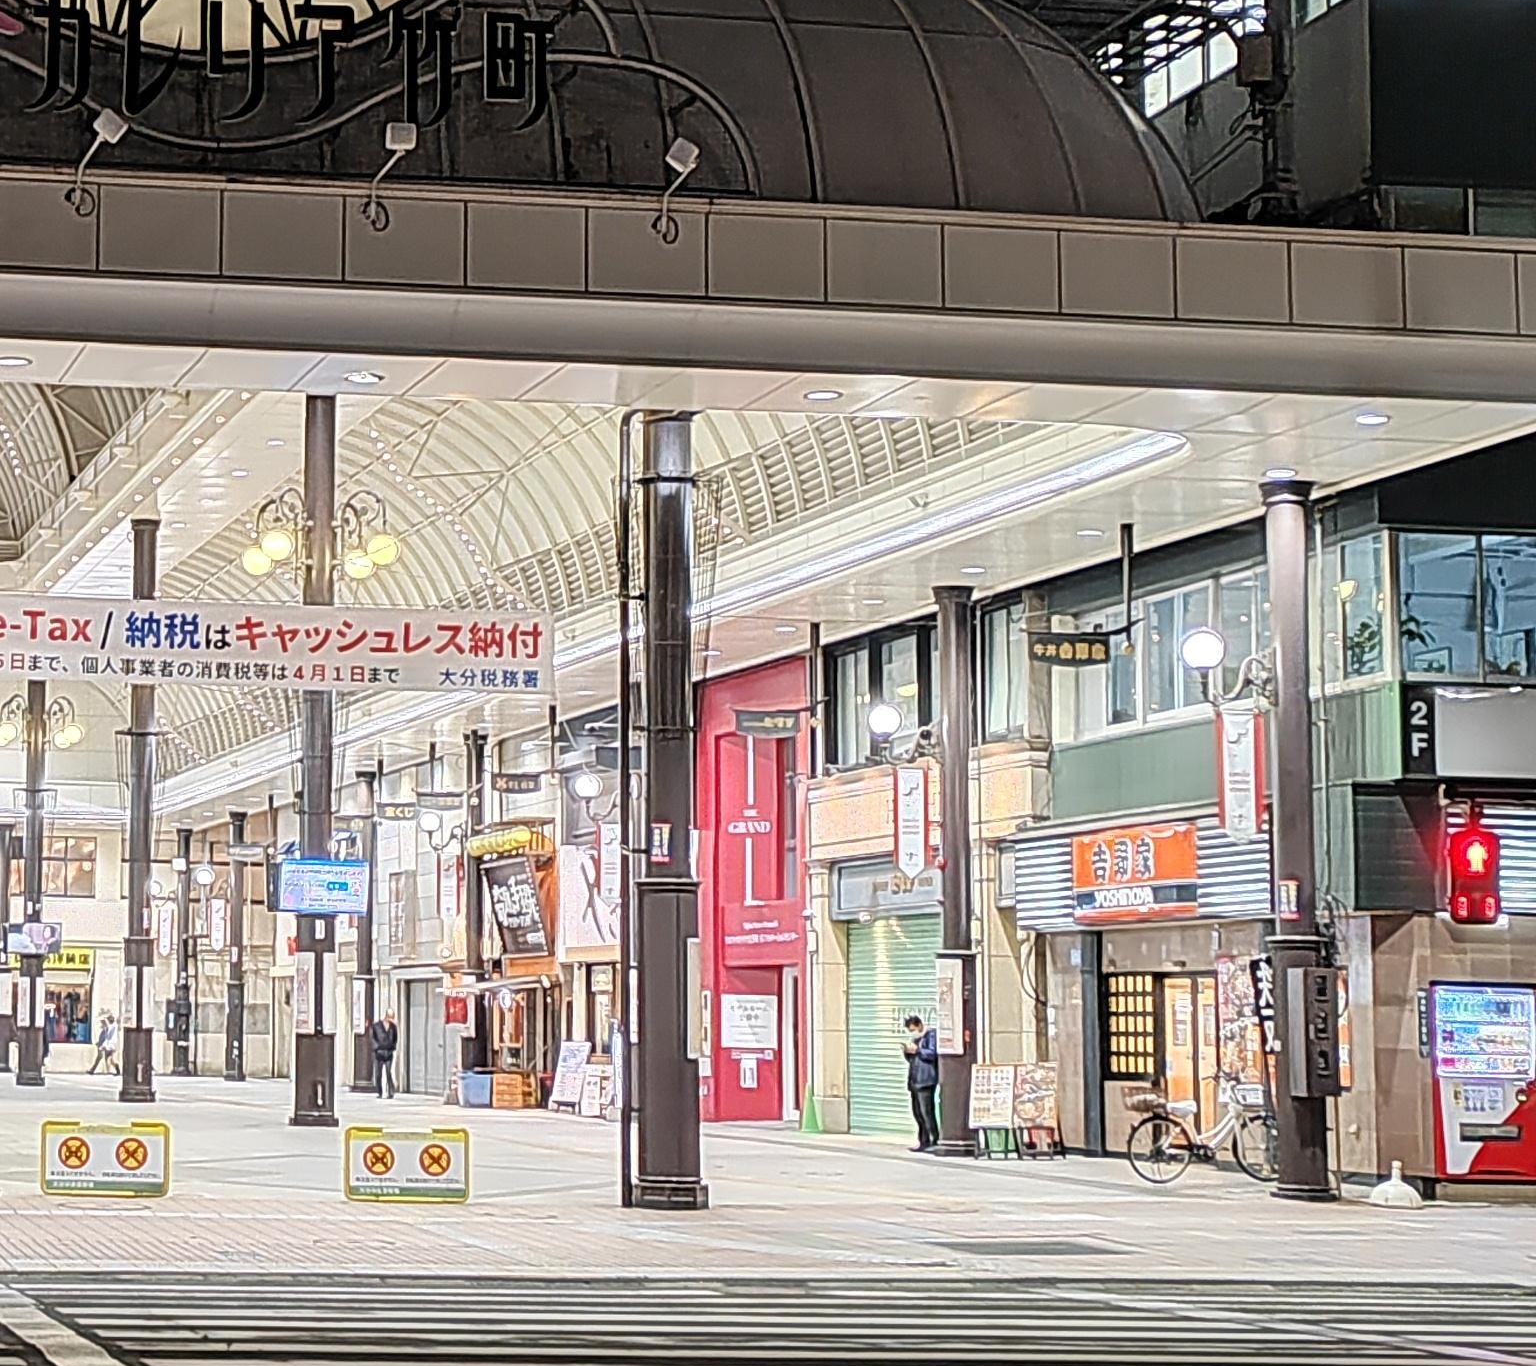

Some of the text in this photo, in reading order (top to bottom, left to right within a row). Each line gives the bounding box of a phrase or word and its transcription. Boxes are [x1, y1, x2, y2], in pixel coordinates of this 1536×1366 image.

[125, 610, 544, 659] 納税はキャッシュレス納付
[439, 668, 541, 689] 大分税務署
[1090, 835, 1155, 884] 吉野家
[1094, 886, 1154, 908] YOSHINOYA
